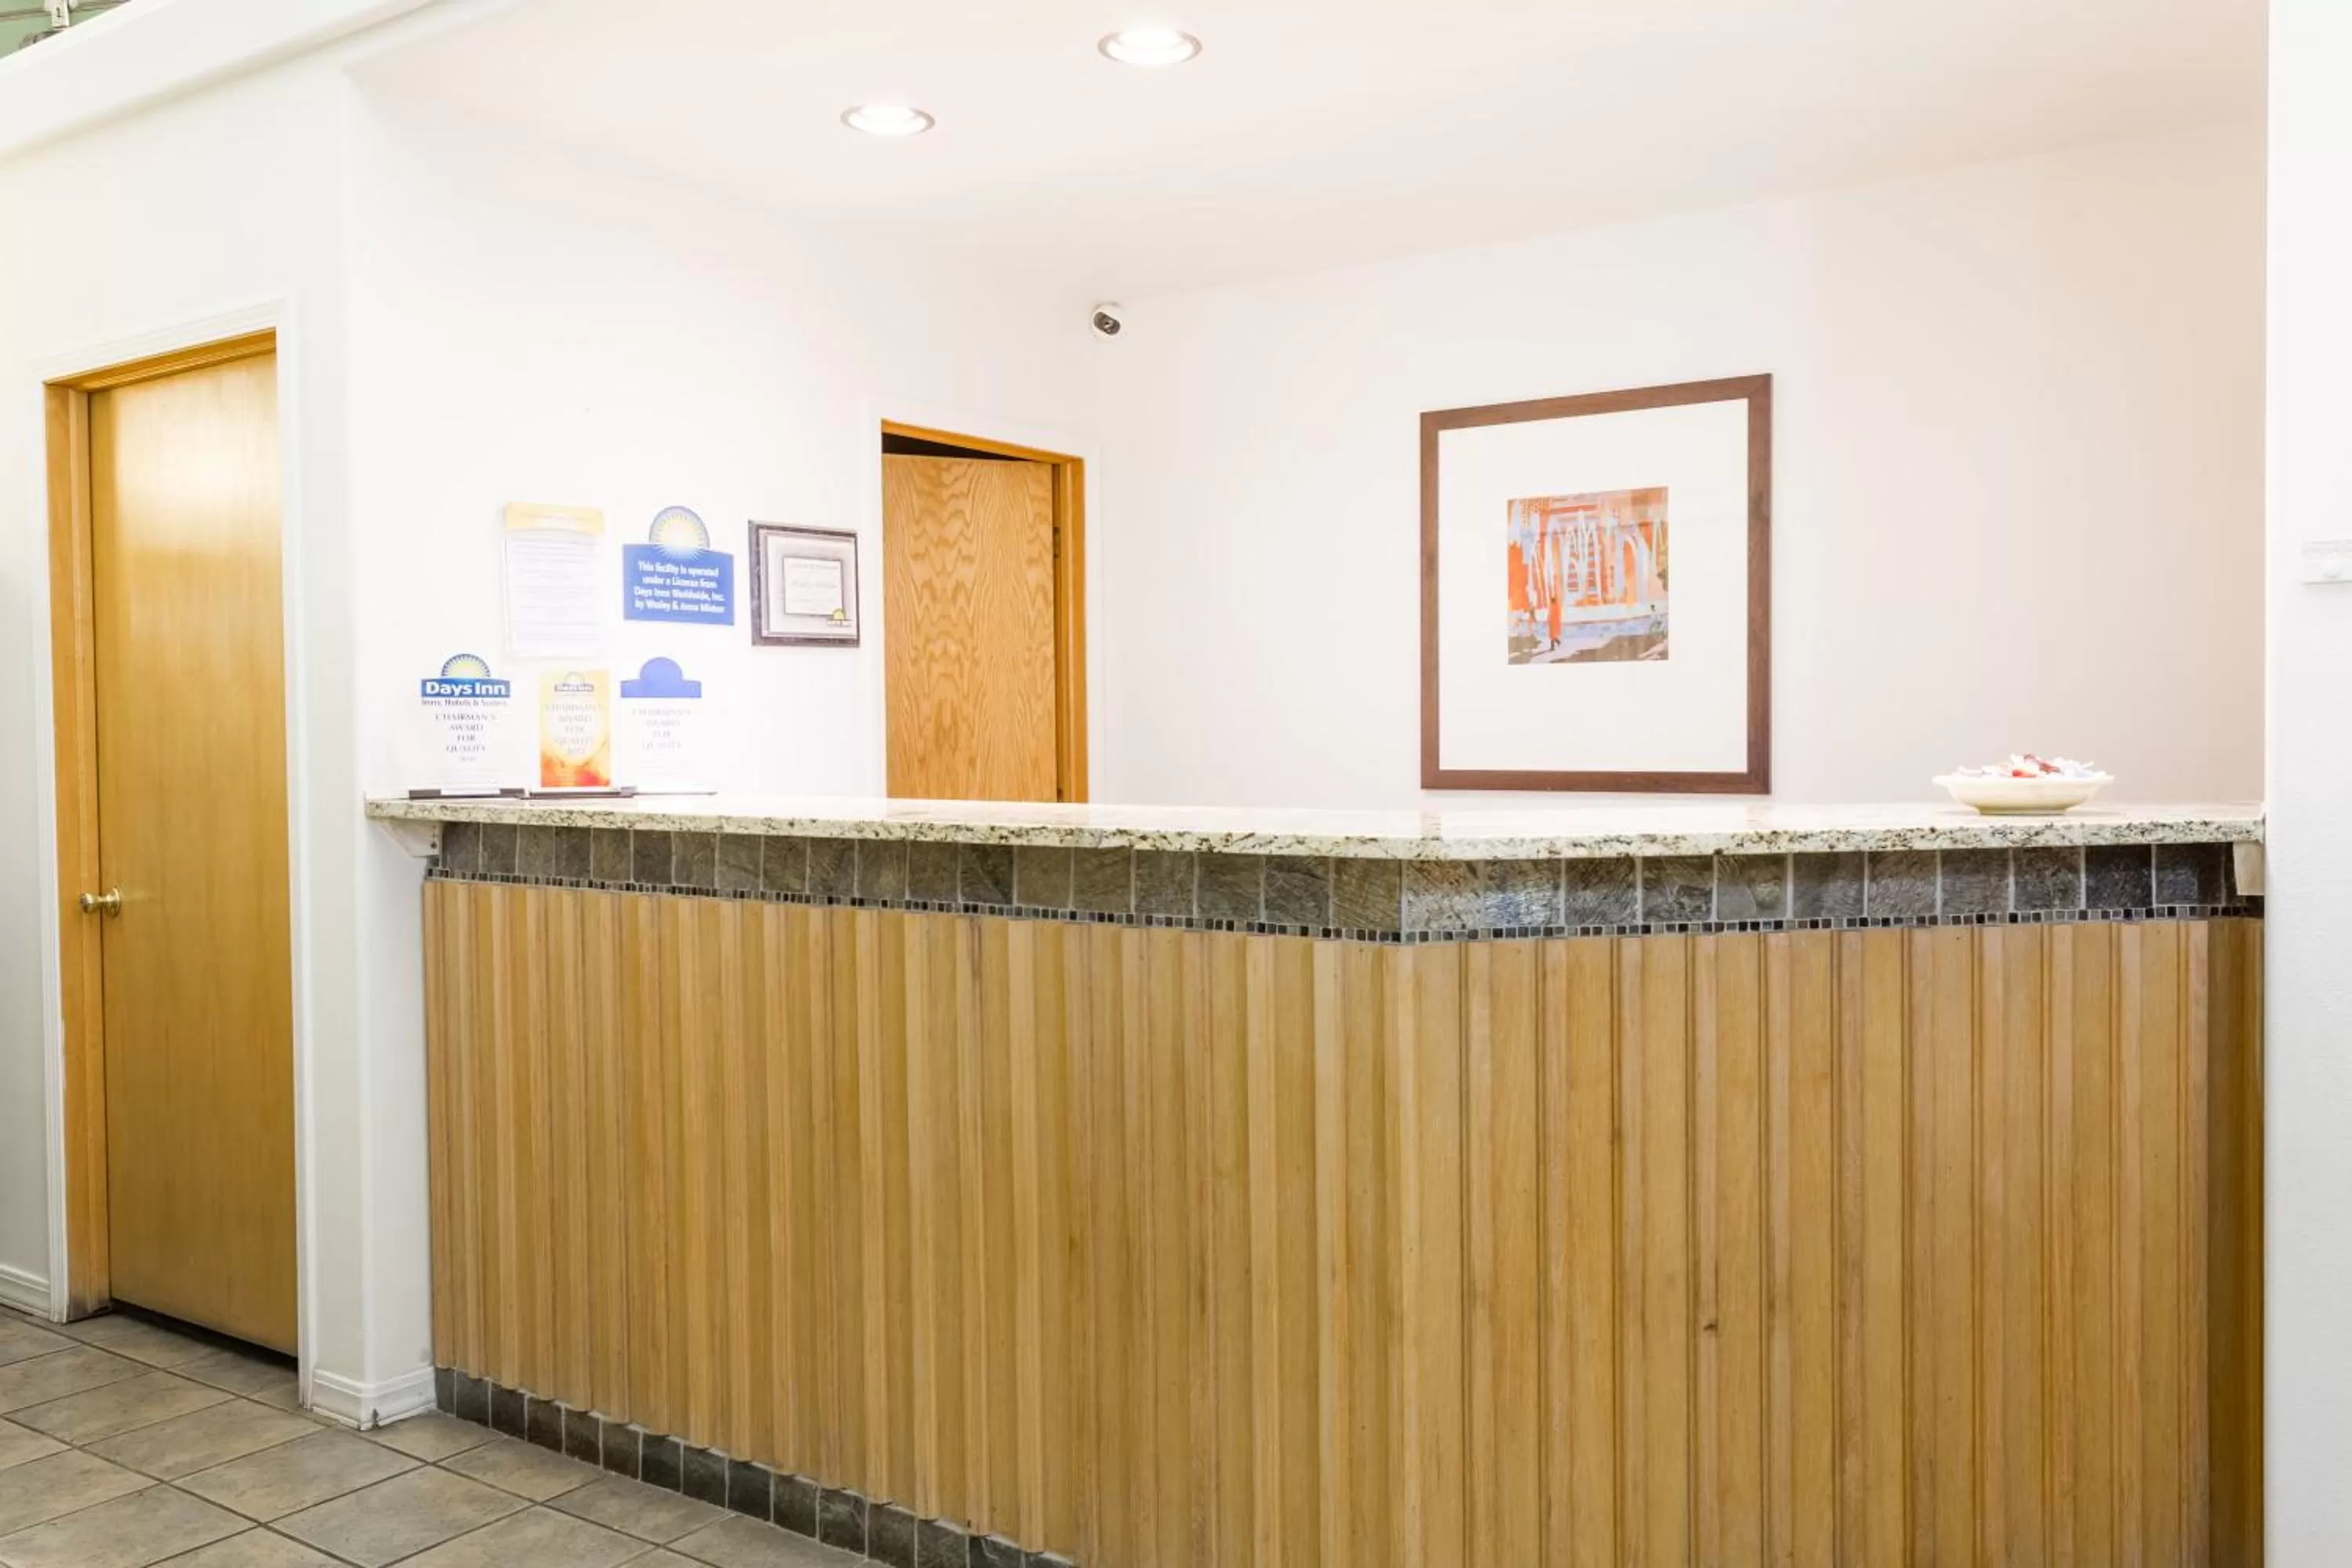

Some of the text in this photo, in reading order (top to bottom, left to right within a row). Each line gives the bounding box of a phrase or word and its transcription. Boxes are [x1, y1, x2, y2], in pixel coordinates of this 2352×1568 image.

[633, 585, 652, 597] Days
[426, 681, 506, 696] Days Inn
[449, 723, 484, 731] AWARD
[456, 733, 476, 742] FOR
